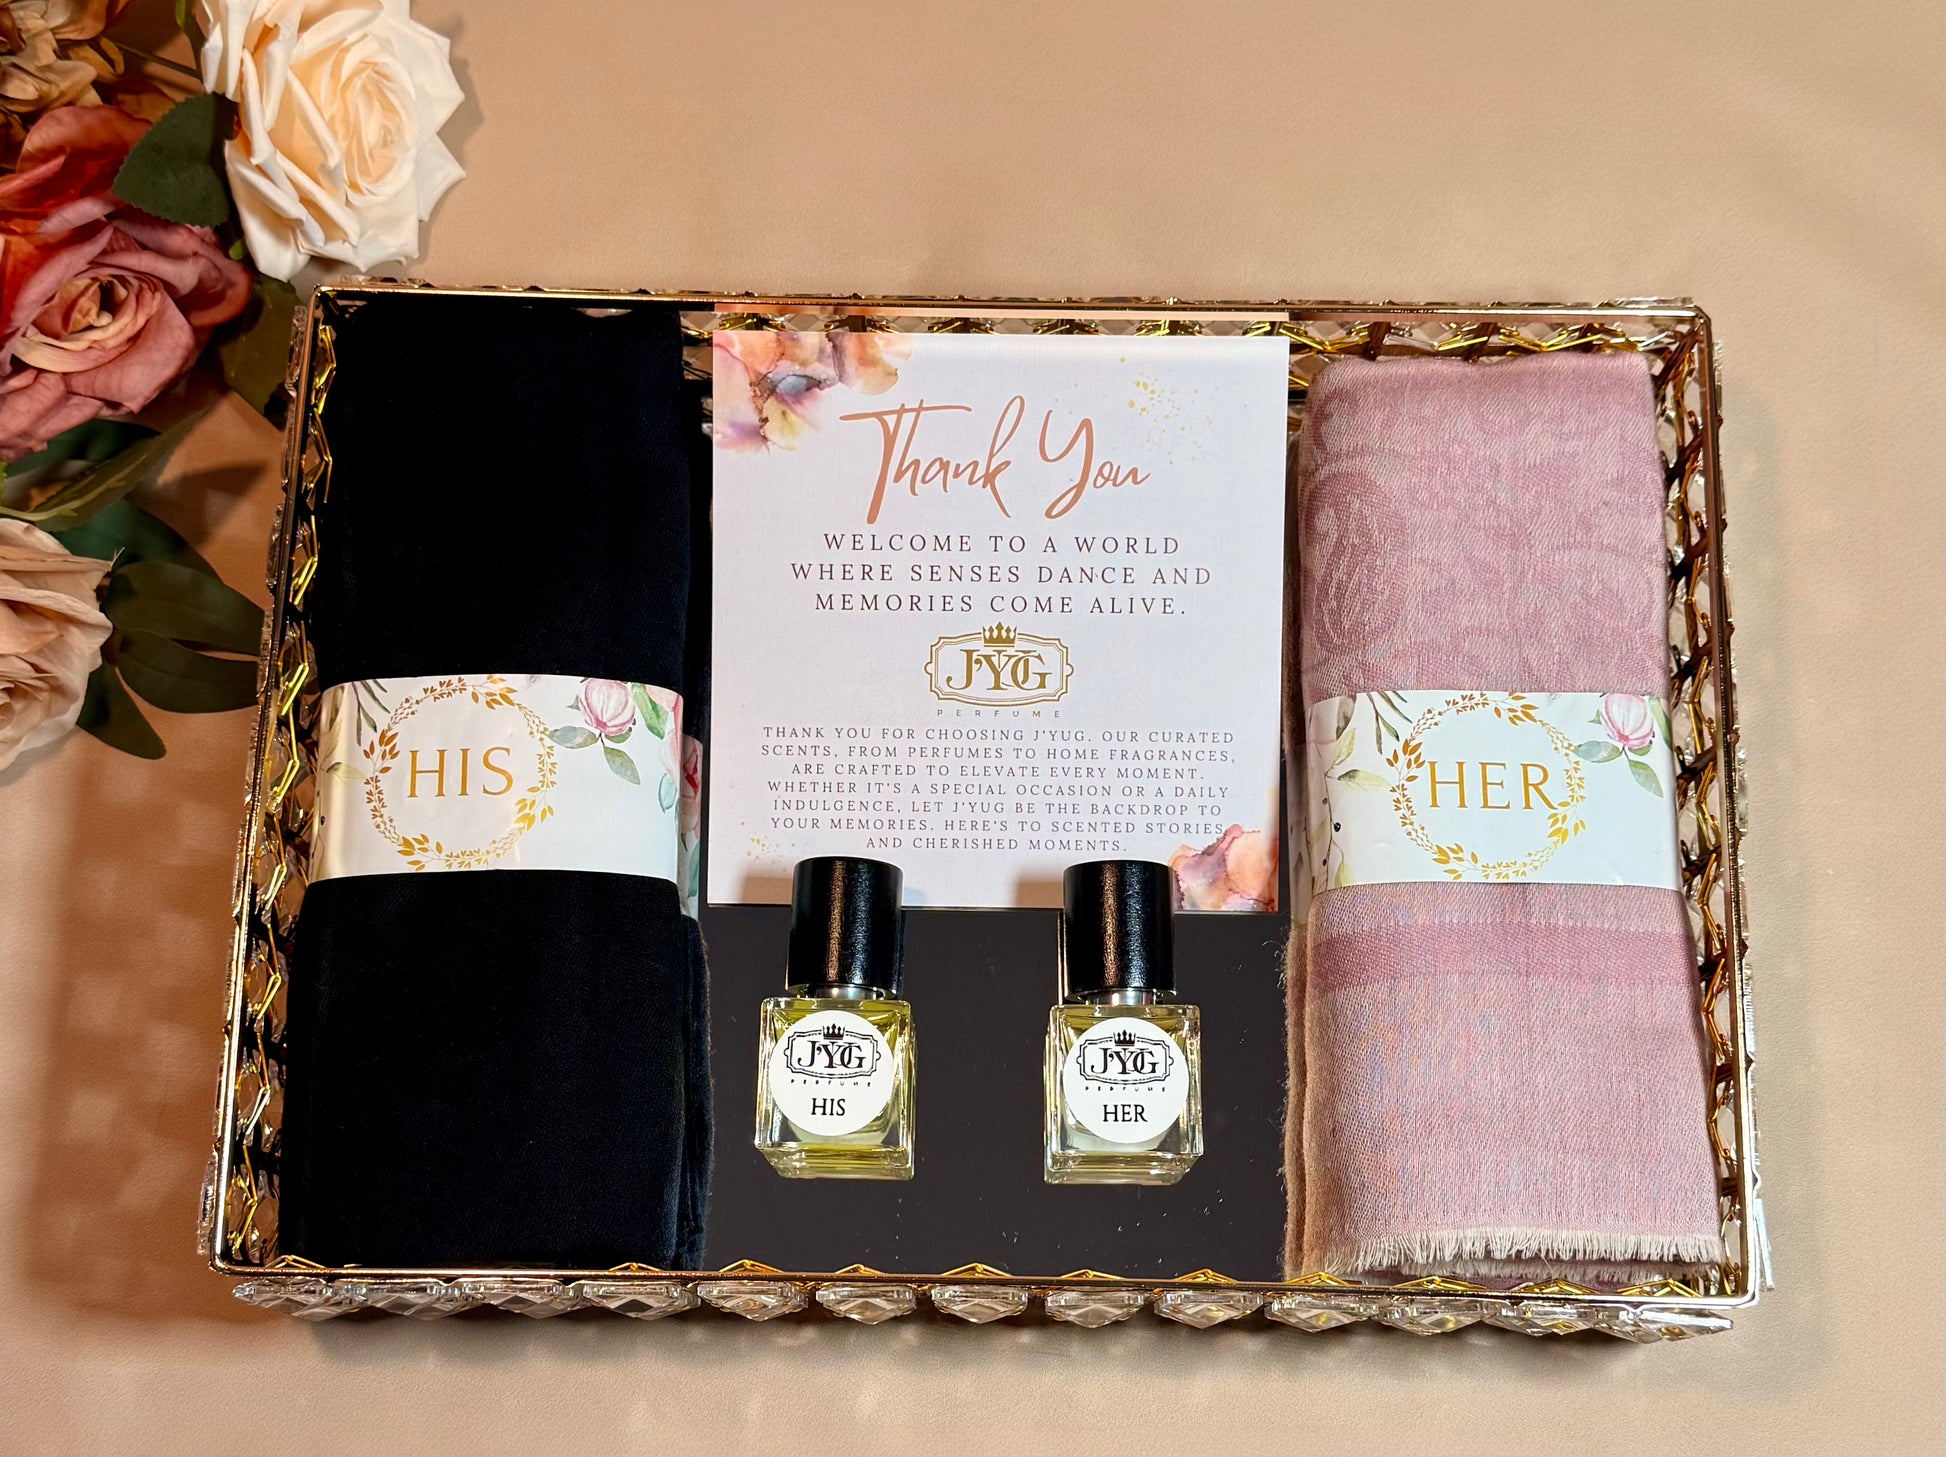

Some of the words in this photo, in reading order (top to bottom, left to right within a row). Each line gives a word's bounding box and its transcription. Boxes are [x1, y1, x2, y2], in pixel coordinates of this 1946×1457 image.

[839, 395, 1025, 524] Thank
[1039, 408, 1151, 519] You
[824, 534, 971, 551] WELCOME
[989, 536, 1025, 552] TO
[1043, 537, 1057, 552] A
[1074, 537, 1178, 554] WORLD
[791, 563, 892, 581] WHERE
[911, 565, 1019, 583] SENSES
[1038, 566, 1134, 583] DANCE
[1152, 568, 1210, 584] AND
[816, 594, 971, 612] MEMORIES
[990, 596, 1072, 613] COME
[1090, 597, 1184, 614] ALIVE.
[936, 708, 1060, 719] PERFUME
[763, 727, 824, 738] THANK
[835, 728, 870, 738] YOU
[882, 728, 915, 739] FOR
[926, 729, 1023, 740] CHOOSING
[1034, 730, 1091, 742] J'YUG.
[1102, 731, 1138, 742] OUR
[1149, 732, 1233, 743] CURATED
[762, 745, 837, 758] SCENTS,
[849, 746, 896, 757] FROM
[909, 747, 1002, 758] PERFUMES
[1013, 748, 1035, 759] TO
[1047, 749, 1098, 759] HOME
[1110, 749, 1234, 763] FRAGRANCES,
[407, 746, 514, 798] HIS
[792, 764, 824, 774] ARE
[835, 764, 916, 775] CRAFTED
[926, 765, 949, 776] TO
[961, 766, 1039, 777] ELEVATE
[1051, 767, 1106, 778] EVERY
[1117, 768, 1203, 779] MOMENT.
[767, 781, 857, 793] WHETHER
[868, 783, 900, 793] IT'S
[912, 784, 920, 794] A
[931, 784, 1005, 795] SPECIAL
[1016, 784, 1111, 796] OCCASION
[1122, 786, 1144, 797] OR
[1155, 787, 1163, 797] A
[1175, 787, 1228, 798] DAILY
[1427, 760, 1558, 811] HER
[773, 800, 901, 814] INDULGENCE,
[912, 801, 943, 812] LET
[953, 802, 1003, 813] J'YUG
[1016, 803, 1035, 813] BE
[1045, 803, 1080, 814] THE
[1091, 804, 1187, 815] BACKDROP
[1198, 805, 1221, 816] TO
[771, 818, 819, 829] YOUR
[830, 818, 933, 830] MEMORIES.
[945, 820, 1007, 831] HERE'S
[1018, 821, 1041, 832] TO
[1052, 821, 1135, 833] SCENTED
[1145, 822, 1224, 834] STORIES
[866, 837, 902, 848] AND
[913, 838, 1017, 849] CHERISHED
[1029, 839, 1126, 851] MOMENTS.
[811, 1097, 846, 1116] HIS
[1103, 1104, 1148, 1122] HER
